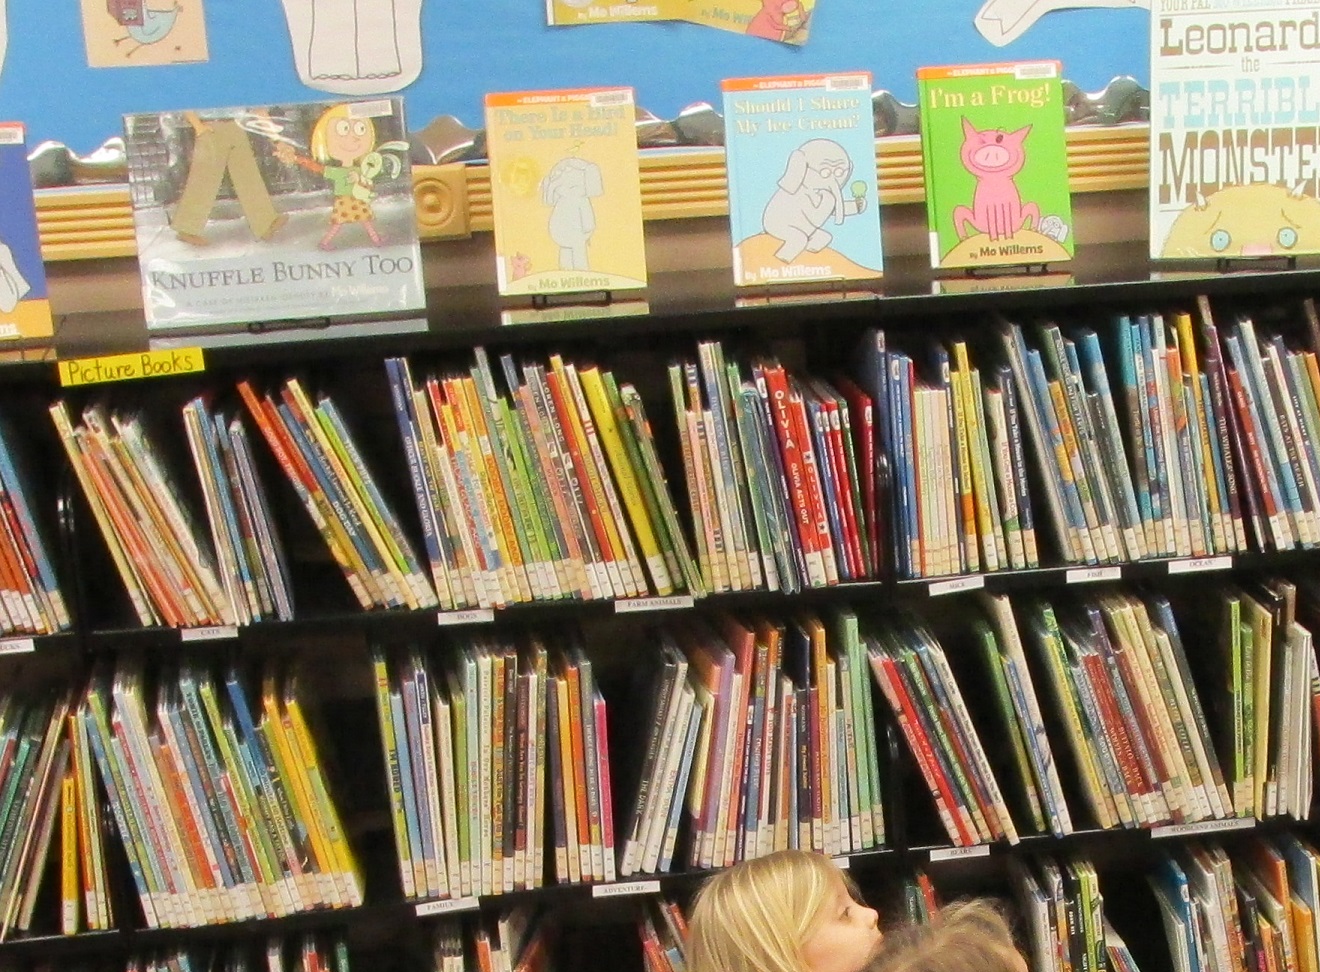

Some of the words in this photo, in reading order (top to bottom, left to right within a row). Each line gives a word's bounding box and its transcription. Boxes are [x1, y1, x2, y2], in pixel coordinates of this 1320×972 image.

[1241, 56, 1260, 73] the
[735, 99, 791, 114] Should
[798, 97, 804, 111] I
[811, 96, 859, 111] Share
[930, 88, 964, 109] I'm
[971, 91, 986, 106] a
[990, 83, 1050, 108] Frog!
[496, 108, 546, 125] There
[550, 106, 567, 121] Is
[571, 111, 583, 120] a
[736, 119, 759, 136] My
[767, 119, 791, 132] Ice
[798, 114, 860, 131] Cream?
[503, 130, 524, 141] on
[529, 124, 565, 139] Your
[568, 121, 618, 138] Head!
[979, 246, 997, 258] Mo
[998, 243, 1043, 257] Willems
[151, 267, 265, 290] KNUFFLE
[272, 260, 357, 283] BUNNY
[362, 254, 414, 275] TOO
[759, 266, 780, 279] Mo
[781, 265, 831, 277] Willems
[538, 277, 557, 289] Mo
[560, 275, 610, 288] Willems
[68, 358, 135, 384] Picture
[141, 352, 193, 376] Books
[774, 390, 795, 448] OLIVIA
[1219, 417, 1229, 432] THE
[1221, 435, 1234, 471] WHALES'
[791, 463, 803, 488] OLIVIA
[1226, 474, 1237, 494] SONG
[796, 489, 806, 507] ACTS
[808, 466, 824, 520] OLIVIA
[800, 509, 809, 524] OUT
[388, 749, 398, 761] I'M
[390, 764, 401, 793] BORED
[1210, 821, 1239, 829] ANIMALS
[427, 901, 454, 911] FAMILY
